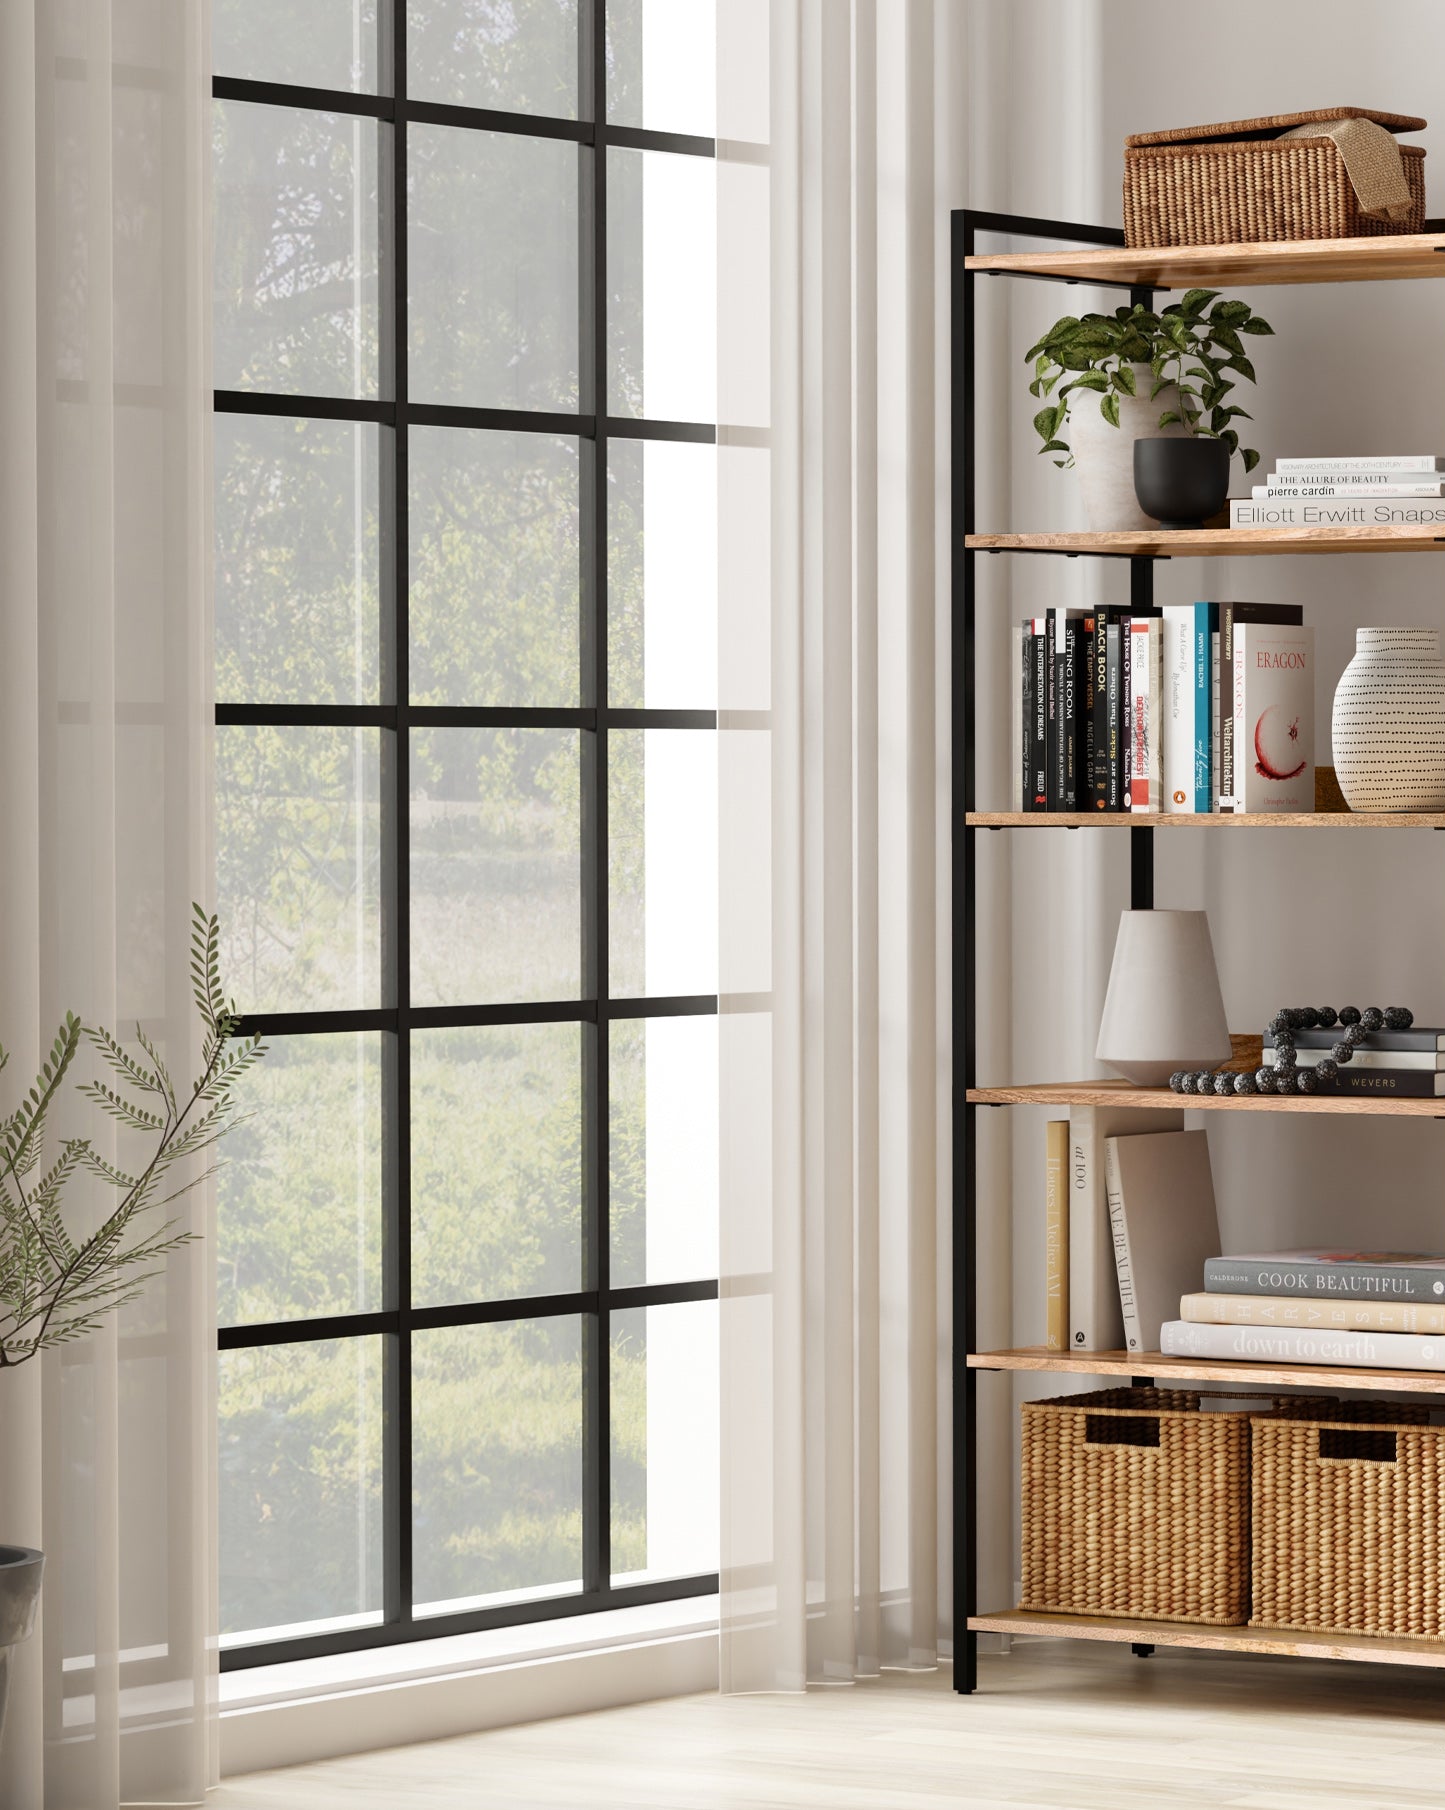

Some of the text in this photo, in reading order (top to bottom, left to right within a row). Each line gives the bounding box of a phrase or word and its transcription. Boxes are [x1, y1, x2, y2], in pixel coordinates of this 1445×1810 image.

[1279, 476, 1389, 484] THE ALLURE OF BEAUTY
[1267, 485, 1335, 498] pierre cardin
[1236, 507, 1295, 523] Elliott
[1304, 506, 1366, 522] Erwitt
[1097, 613, 1106, 692] BLACK BOOK
[1256, 652, 1306, 669] ERAGON
[1236, 650, 1244, 718] ERAGON
[1037, 704, 1044, 714] OF
[1224, 716, 1233, 796] Weltarchitektur
[1351, 1079, 1396, 1088] WEVERS
[1075, 1146, 1087, 1160] at
[1048, 1158, 1060, 1208] Houses
[1075, 1164, 1087, 1190] 100
[1048, 1222, 1060, 1297] Atelier AM
[1108, 1192, 1136, 1324] LIVE BEAUTIFUL
[1258, 1272, 1414, 1294] COOK BEAUTIFUL
[1237, 1304, 1394, 1325] HARVEST
[1234, 1334, 1292, 1356] down
[1296, 1338, 1316, 1358] to
[1320, 1337, 1376, 1360] earth
